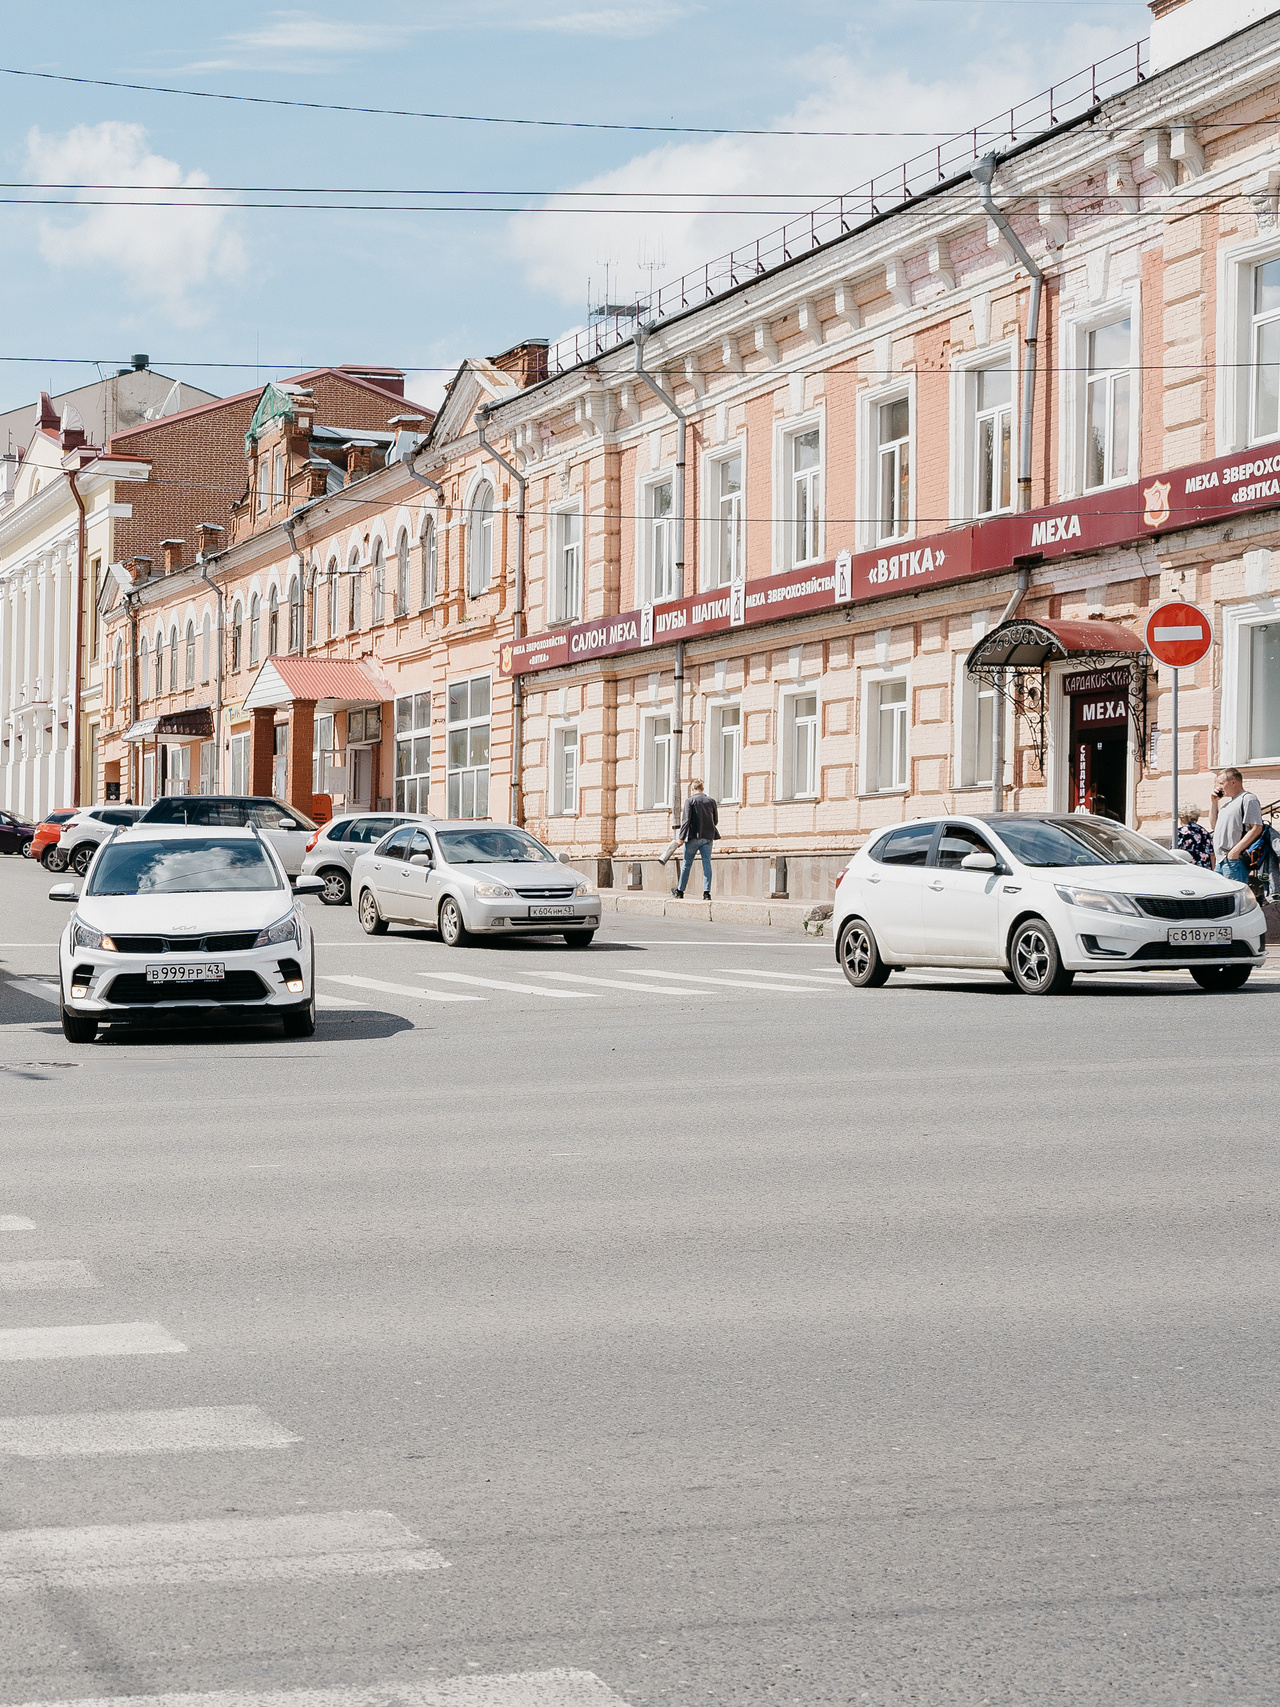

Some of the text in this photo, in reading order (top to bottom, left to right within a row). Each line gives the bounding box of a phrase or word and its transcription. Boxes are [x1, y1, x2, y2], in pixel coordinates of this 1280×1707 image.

[1185, 471, 1219, 494] МЕХА
[1031, 515, 1081, 547] МЕХА
[868, 547, 945, 584] «ВЯТКА»
[746, 576, 836, 608] МЕХА ЗВЕРОХОЗЯЙСТВА
[656, 597, 730, 633] ШУБЫ ШАПКИ
[513, 635, 567, 656] МЕХА ЗВЕРОХОЗЯЙСТВА
[571, 621, 637, 652] САЛОН МЕХА
[1083, 701, 1126, 721] МЕХА
[1218, 928, 1228, 937] 43
[207, 965, 219, 974] 43
